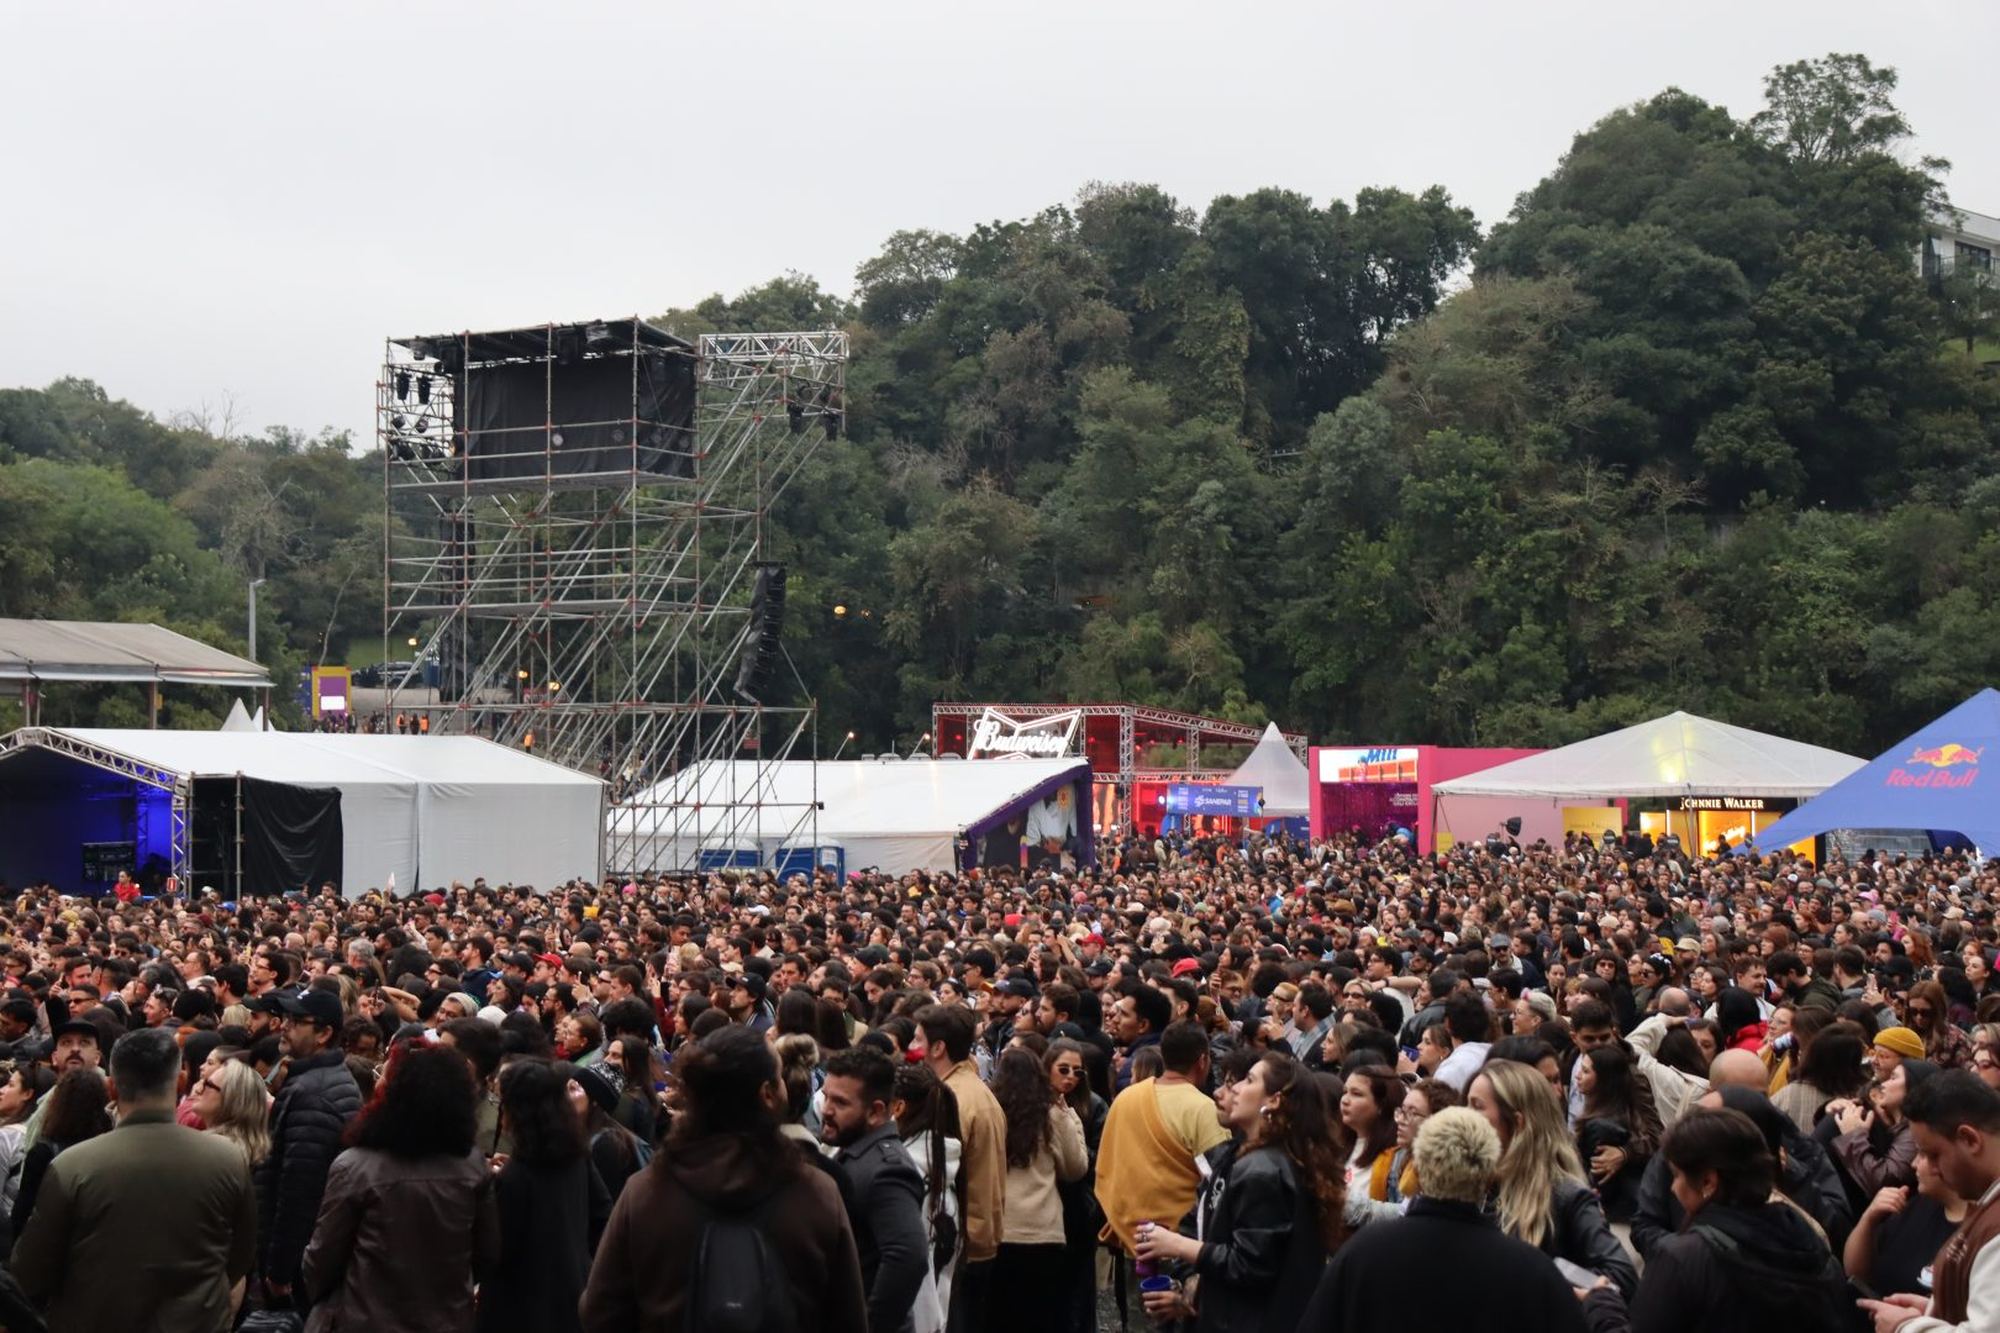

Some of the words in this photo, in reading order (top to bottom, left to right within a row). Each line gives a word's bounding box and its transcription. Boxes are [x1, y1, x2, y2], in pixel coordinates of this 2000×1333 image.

[974, 719, 1068, 752] Budweiser
[1885, 768, 1934, 788] Red
[1932, 768, 1979, 788] Bull
[1724, 797, 1764, 809] WALKER
